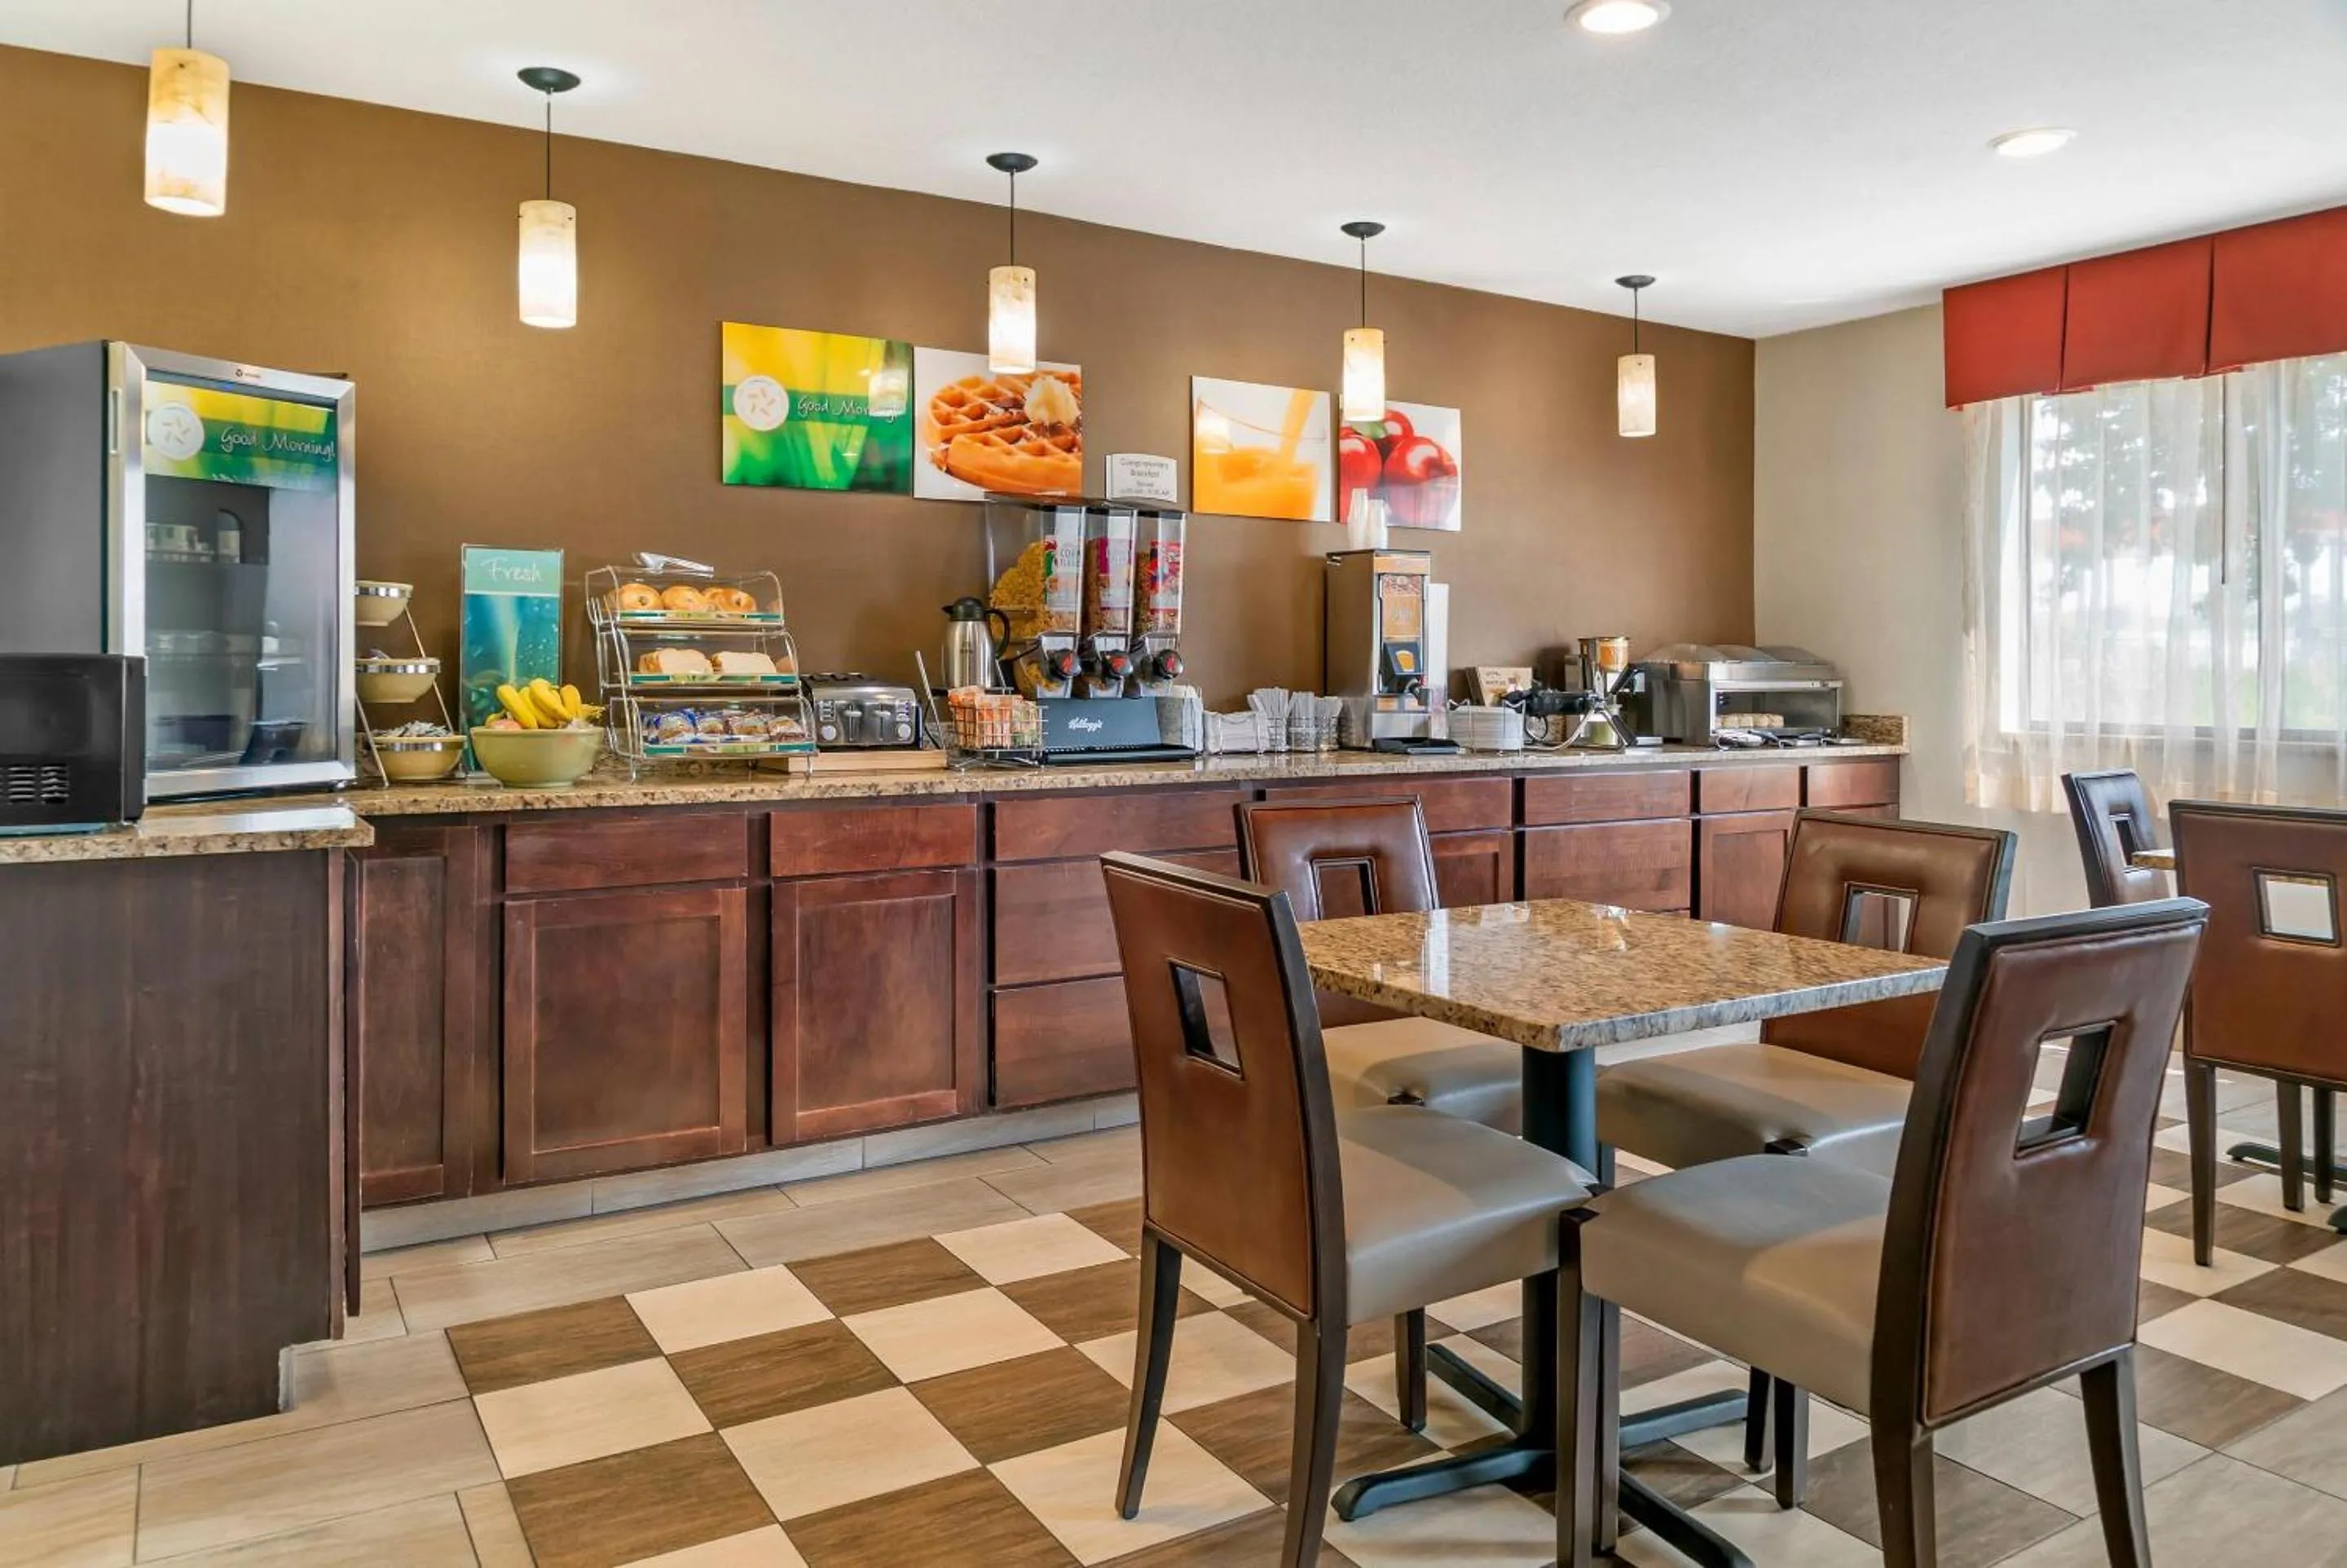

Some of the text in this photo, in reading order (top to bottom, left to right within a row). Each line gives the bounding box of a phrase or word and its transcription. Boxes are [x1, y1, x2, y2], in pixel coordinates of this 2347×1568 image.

[796, 395, 829, 417] Good
[220, 425, 336, 463] Good Morning!
[479, 556, 544, 584] Fresh
